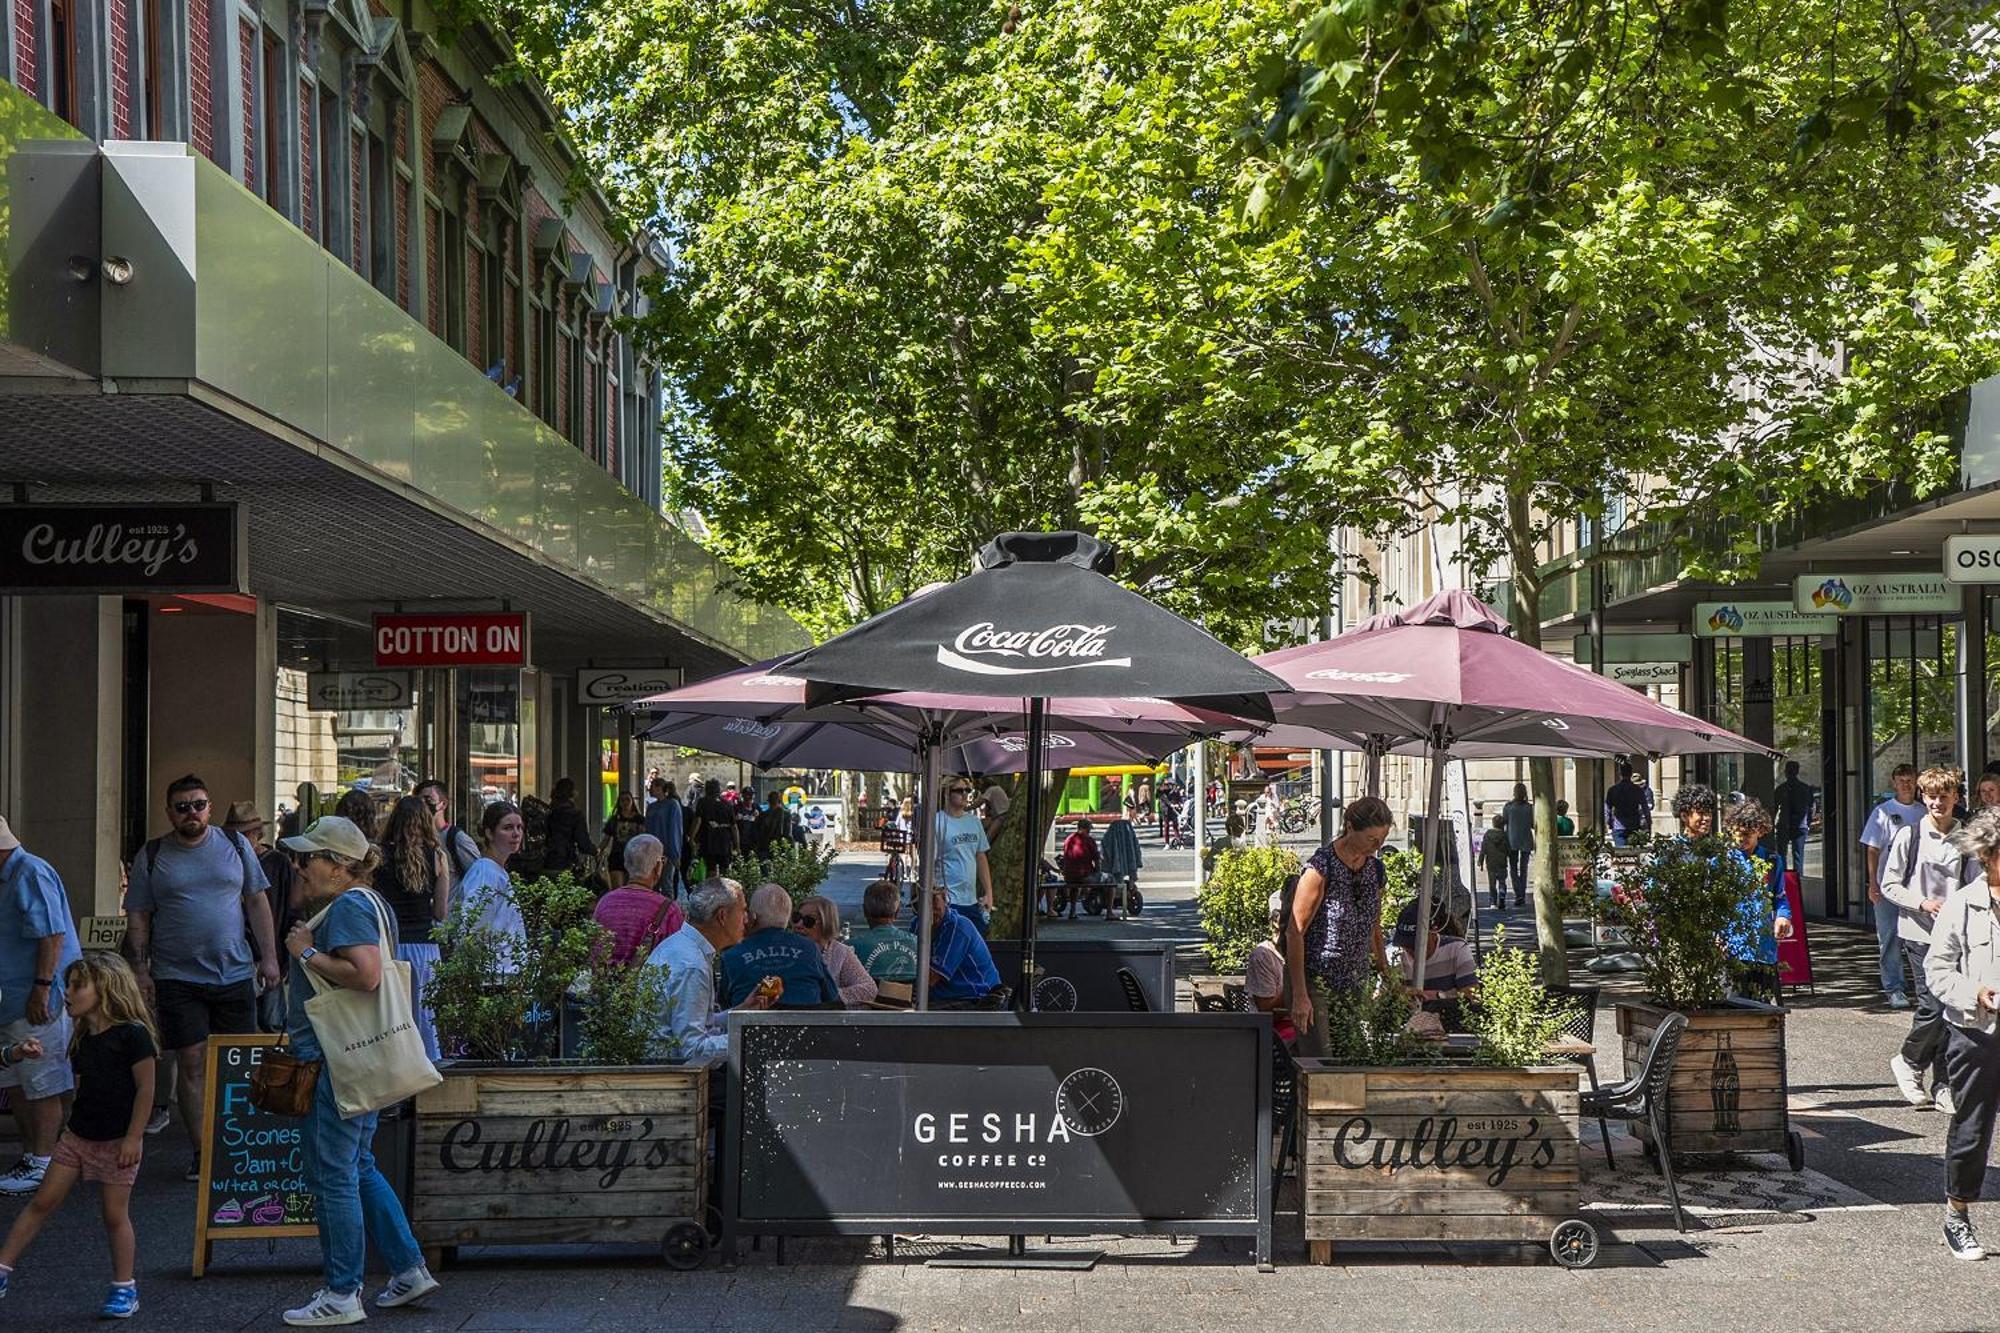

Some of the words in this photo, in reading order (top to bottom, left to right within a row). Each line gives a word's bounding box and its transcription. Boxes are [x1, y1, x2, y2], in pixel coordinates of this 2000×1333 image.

[128, 525, 145, 535] est
[147, 524, 169, 535] 1925
[22, 523, 199, 577] Culley's
[1852, 584, 1873, 595] OZ
[1875, 582, 1947, 595] AUSTRALIA
[1743, 610, 1760, 620] OZ
[377, 626, 478, 655] COTTON
[486, 625, 520, 653] ON
[954, 621, 1118, 658] Coca-Cola
[1614, 667, 1652, 679] Sunglass
[1652, 665, 1678, 678] Shack
[742, 945, 803, 966] BALLY
[223, 1118, 301, 1147] Scones
[914, 1113, 1070, 1144] GESHA
[1466, 1120, 1486, 1131] est
[1490, 1119, 1519, 1131] 1925
[228, 1149, 277, 1175] Jam
[440, 1117, 670, 1189] Culley's
[938, 1154, 1017, 1167] COFFEE
[1333, 1116, 1555, 1188] Culley's
[938, 1181, 1046, 1190] WWW.GESHACOFFEECO.COM
